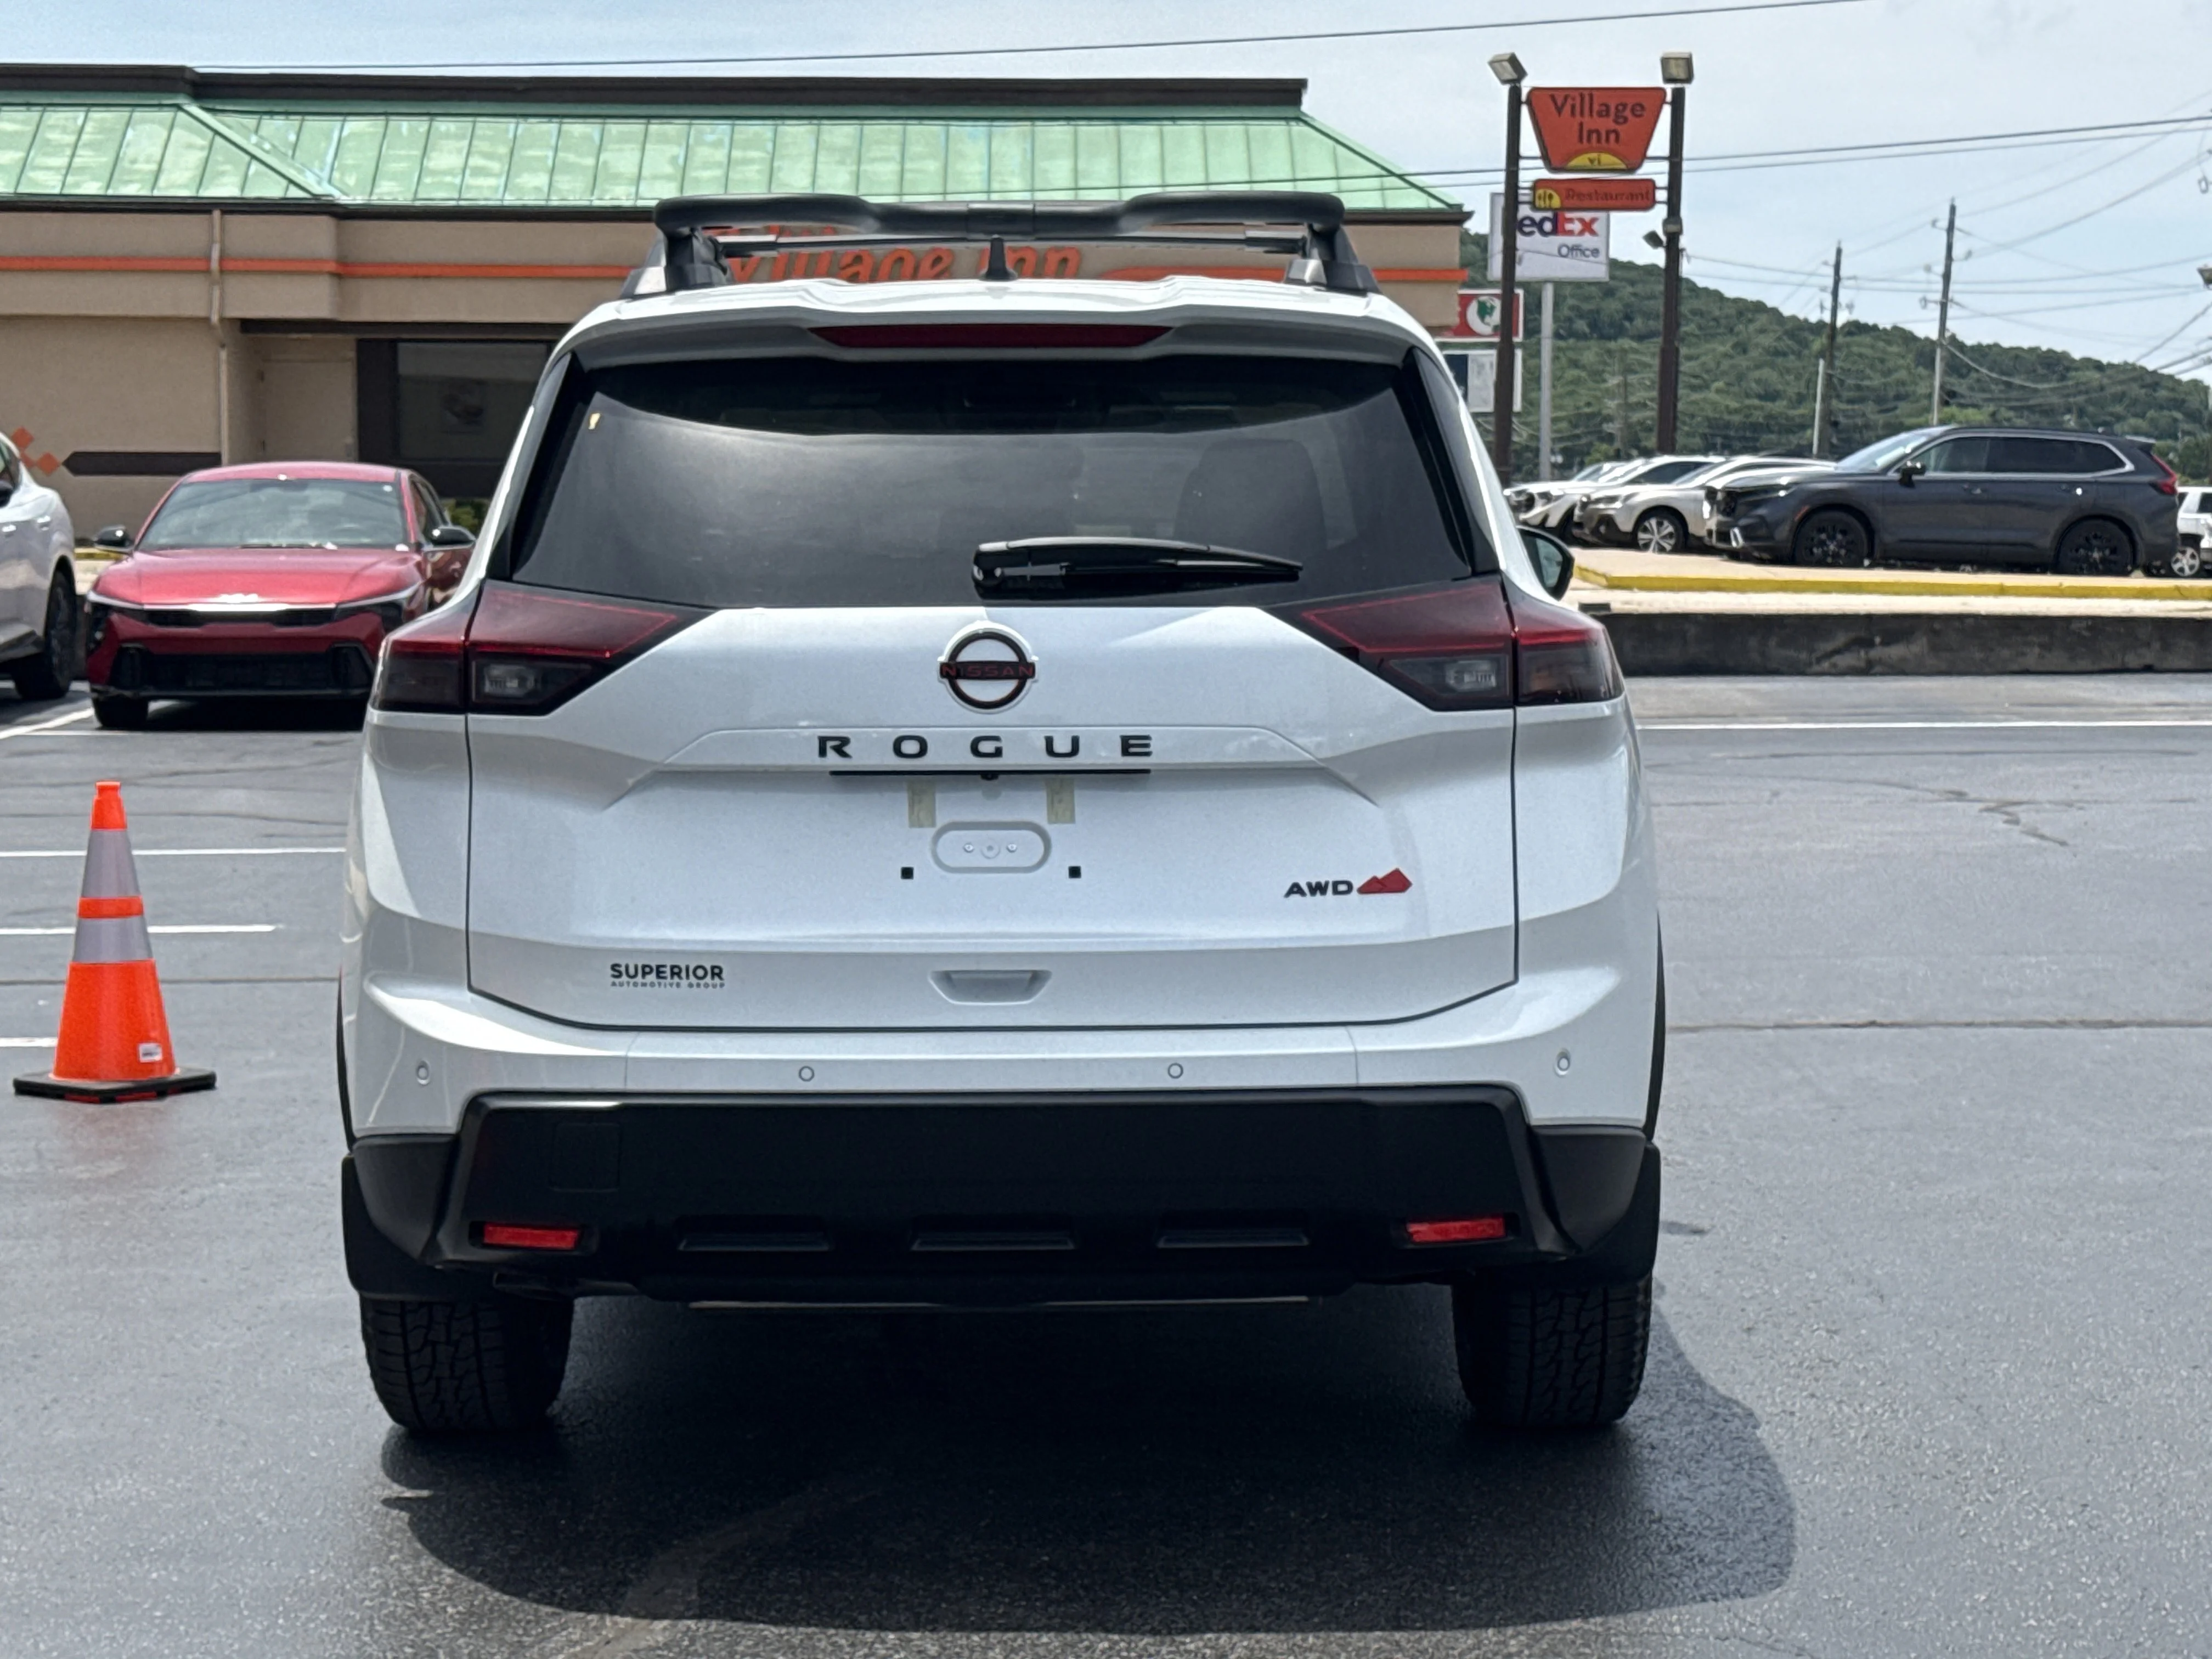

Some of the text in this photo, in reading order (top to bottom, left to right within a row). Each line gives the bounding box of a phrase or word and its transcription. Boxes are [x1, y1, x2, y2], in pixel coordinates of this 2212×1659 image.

[1549, 92, 1645, 125] Village
[1578, 121, 1620, 144] Inn
[1565, 189, 1650, 202] Restaurant
[1517, 212, 1599, 237] edEx
[1558, 243, 1600, 258] Office
[942, 664, 1034, 677] NISSAN
[817, 735, 1153, 759] ROGUE
[1284, 880, 1353, 898] AWD
[610, 963, 724, 981] SUPERIOR
